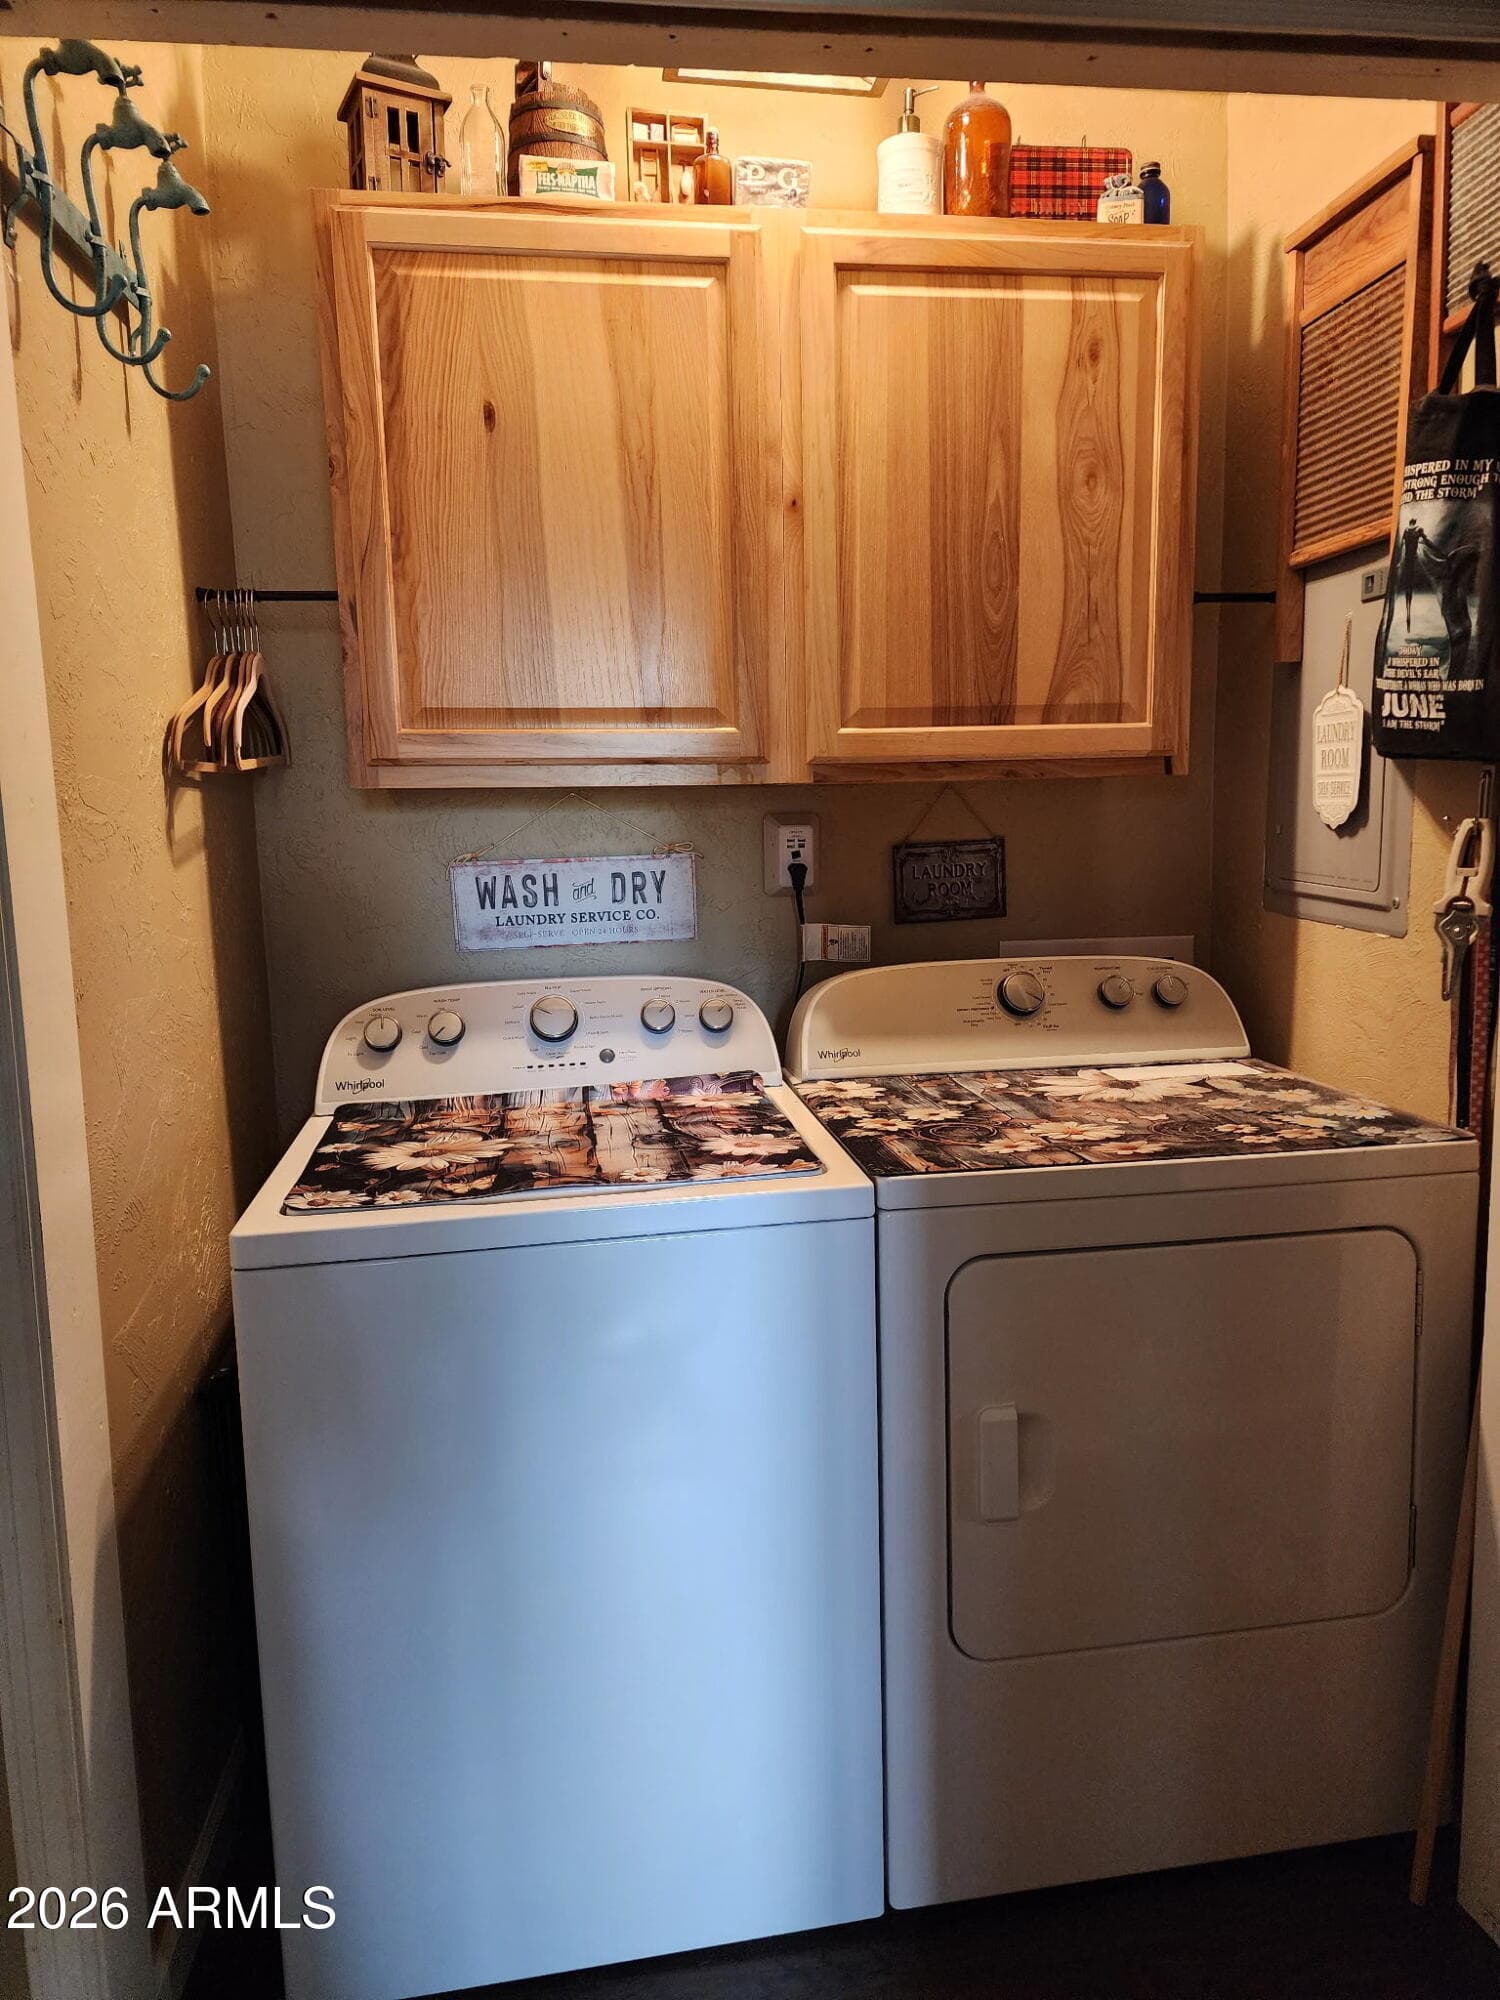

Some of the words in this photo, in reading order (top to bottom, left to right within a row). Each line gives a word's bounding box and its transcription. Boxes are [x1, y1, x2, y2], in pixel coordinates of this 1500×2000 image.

[1455, 459, 1469, 471] IN
[1473, 459, 1494, 472] MY
[1403, 475, 1438, 490] STRONG
[1440, 472, 1490, 486] ENOUGH
[1415, 488, 1435, 501] THE
[1429, 657, 1440, 667] IN
[1397, 667, 1422, 678] DEVIL'S
[1424, 668, 1440, 679] EAR
[1442, 680, 1457, 691] WAS
[1382, 692, 1446, 718] JUNE
[1387, 719, 1398, 729] AM
[1399, 720, 1414, 729] THE
[1317, 721, 1354, 744] LAUNDRY
[1321, 747, 1350, 769] ROOM
[913, 862, 987, 880] LAUNDRY
[475, 872, 559, 910] WASH
[571, 877, 597, 902] and
[611, 870, 666, 904] DRY
[928, 880, 974, 896] ROOM
[495, 912, 566, 927] LAUNDRY
[571, 909, 632, 923] SERVICE
[636, 908, 660, 920] CO.
[572, 925, 598, 937] OPEN
[609, 925, 640, 936] HOURS
[817, 1047, 862, 1063] Whirlpool
[335, 1078, 385, 1094] Whirlpool
